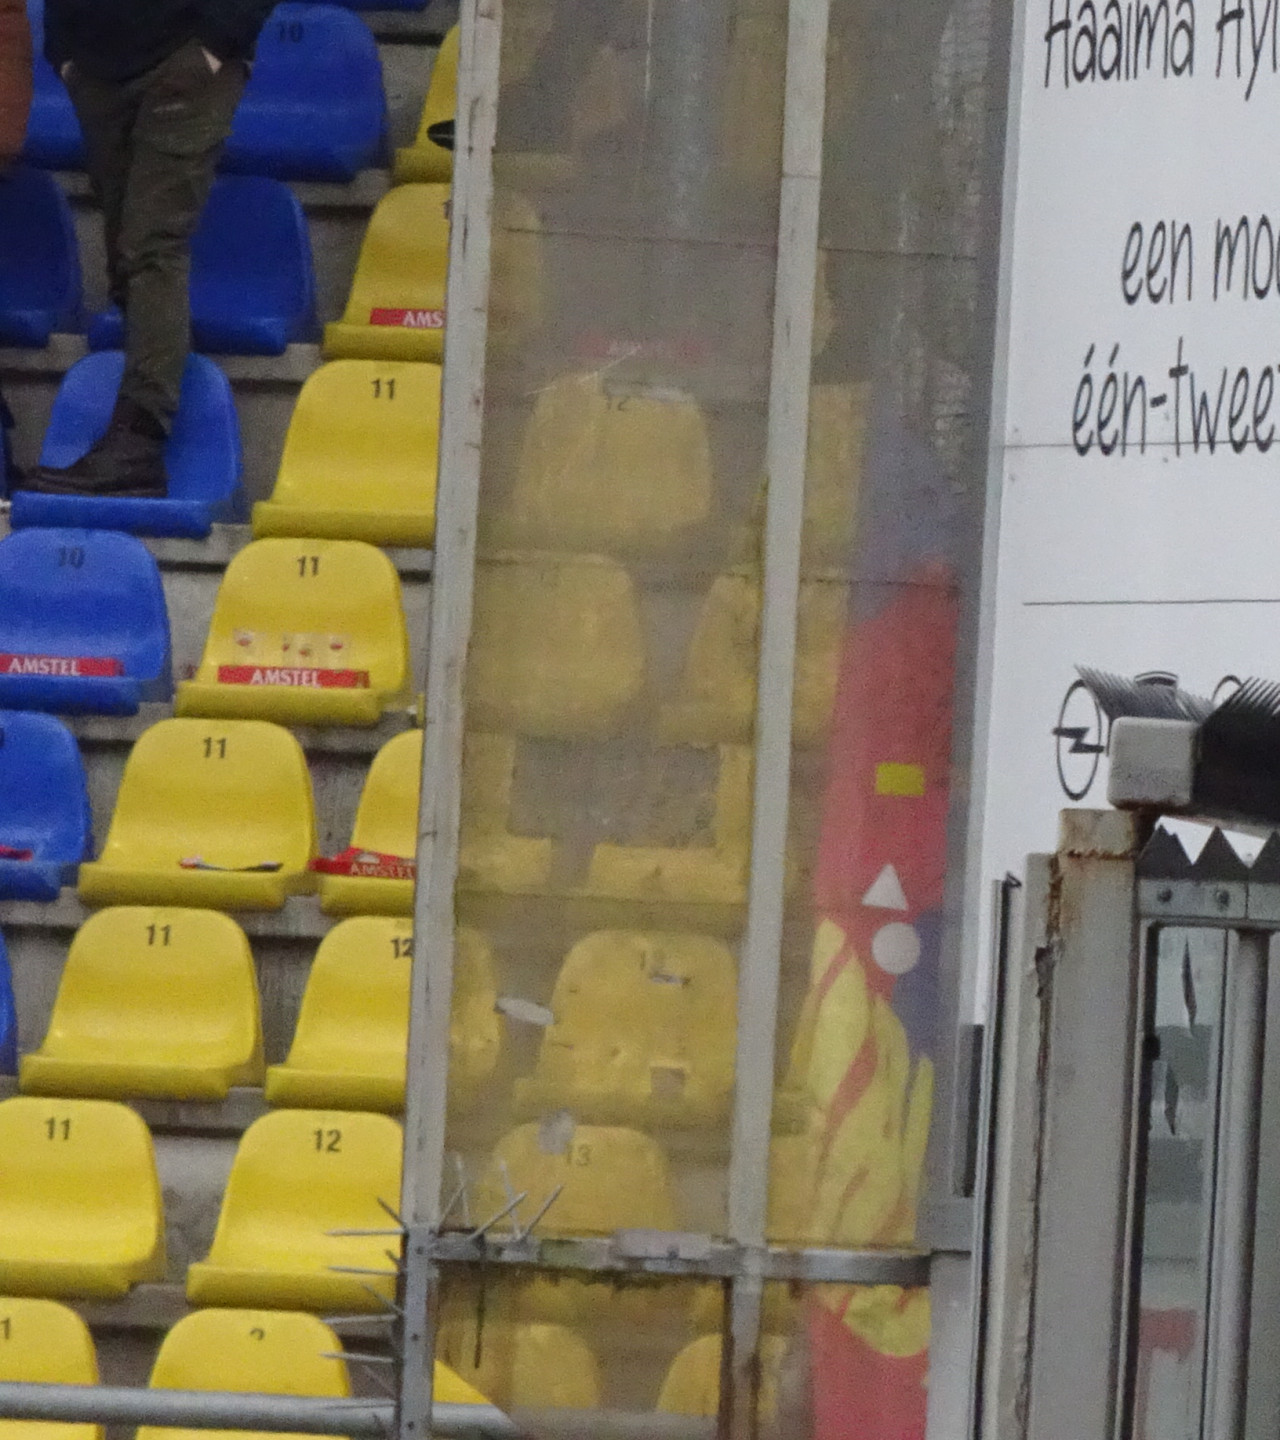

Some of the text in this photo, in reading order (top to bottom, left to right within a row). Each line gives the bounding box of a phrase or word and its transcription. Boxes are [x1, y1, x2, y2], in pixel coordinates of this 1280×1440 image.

[1121, 218, 1193, 305] een
[402, 311, 444, 328] AMS
[370, 377, 397, 400] 11
[296, 556, 321, 578] 11
[8, 657, 81, 677] AMSTEL
[251, 669, 321, 689] AMSTEL
[202, 737, 227, 760] 11
[145, 924, 172, 947] 11
[390, 937, 413, 959] 12
[44, 1117, 72, 1141] 11
[313, 1129, 343, 1153] 12
